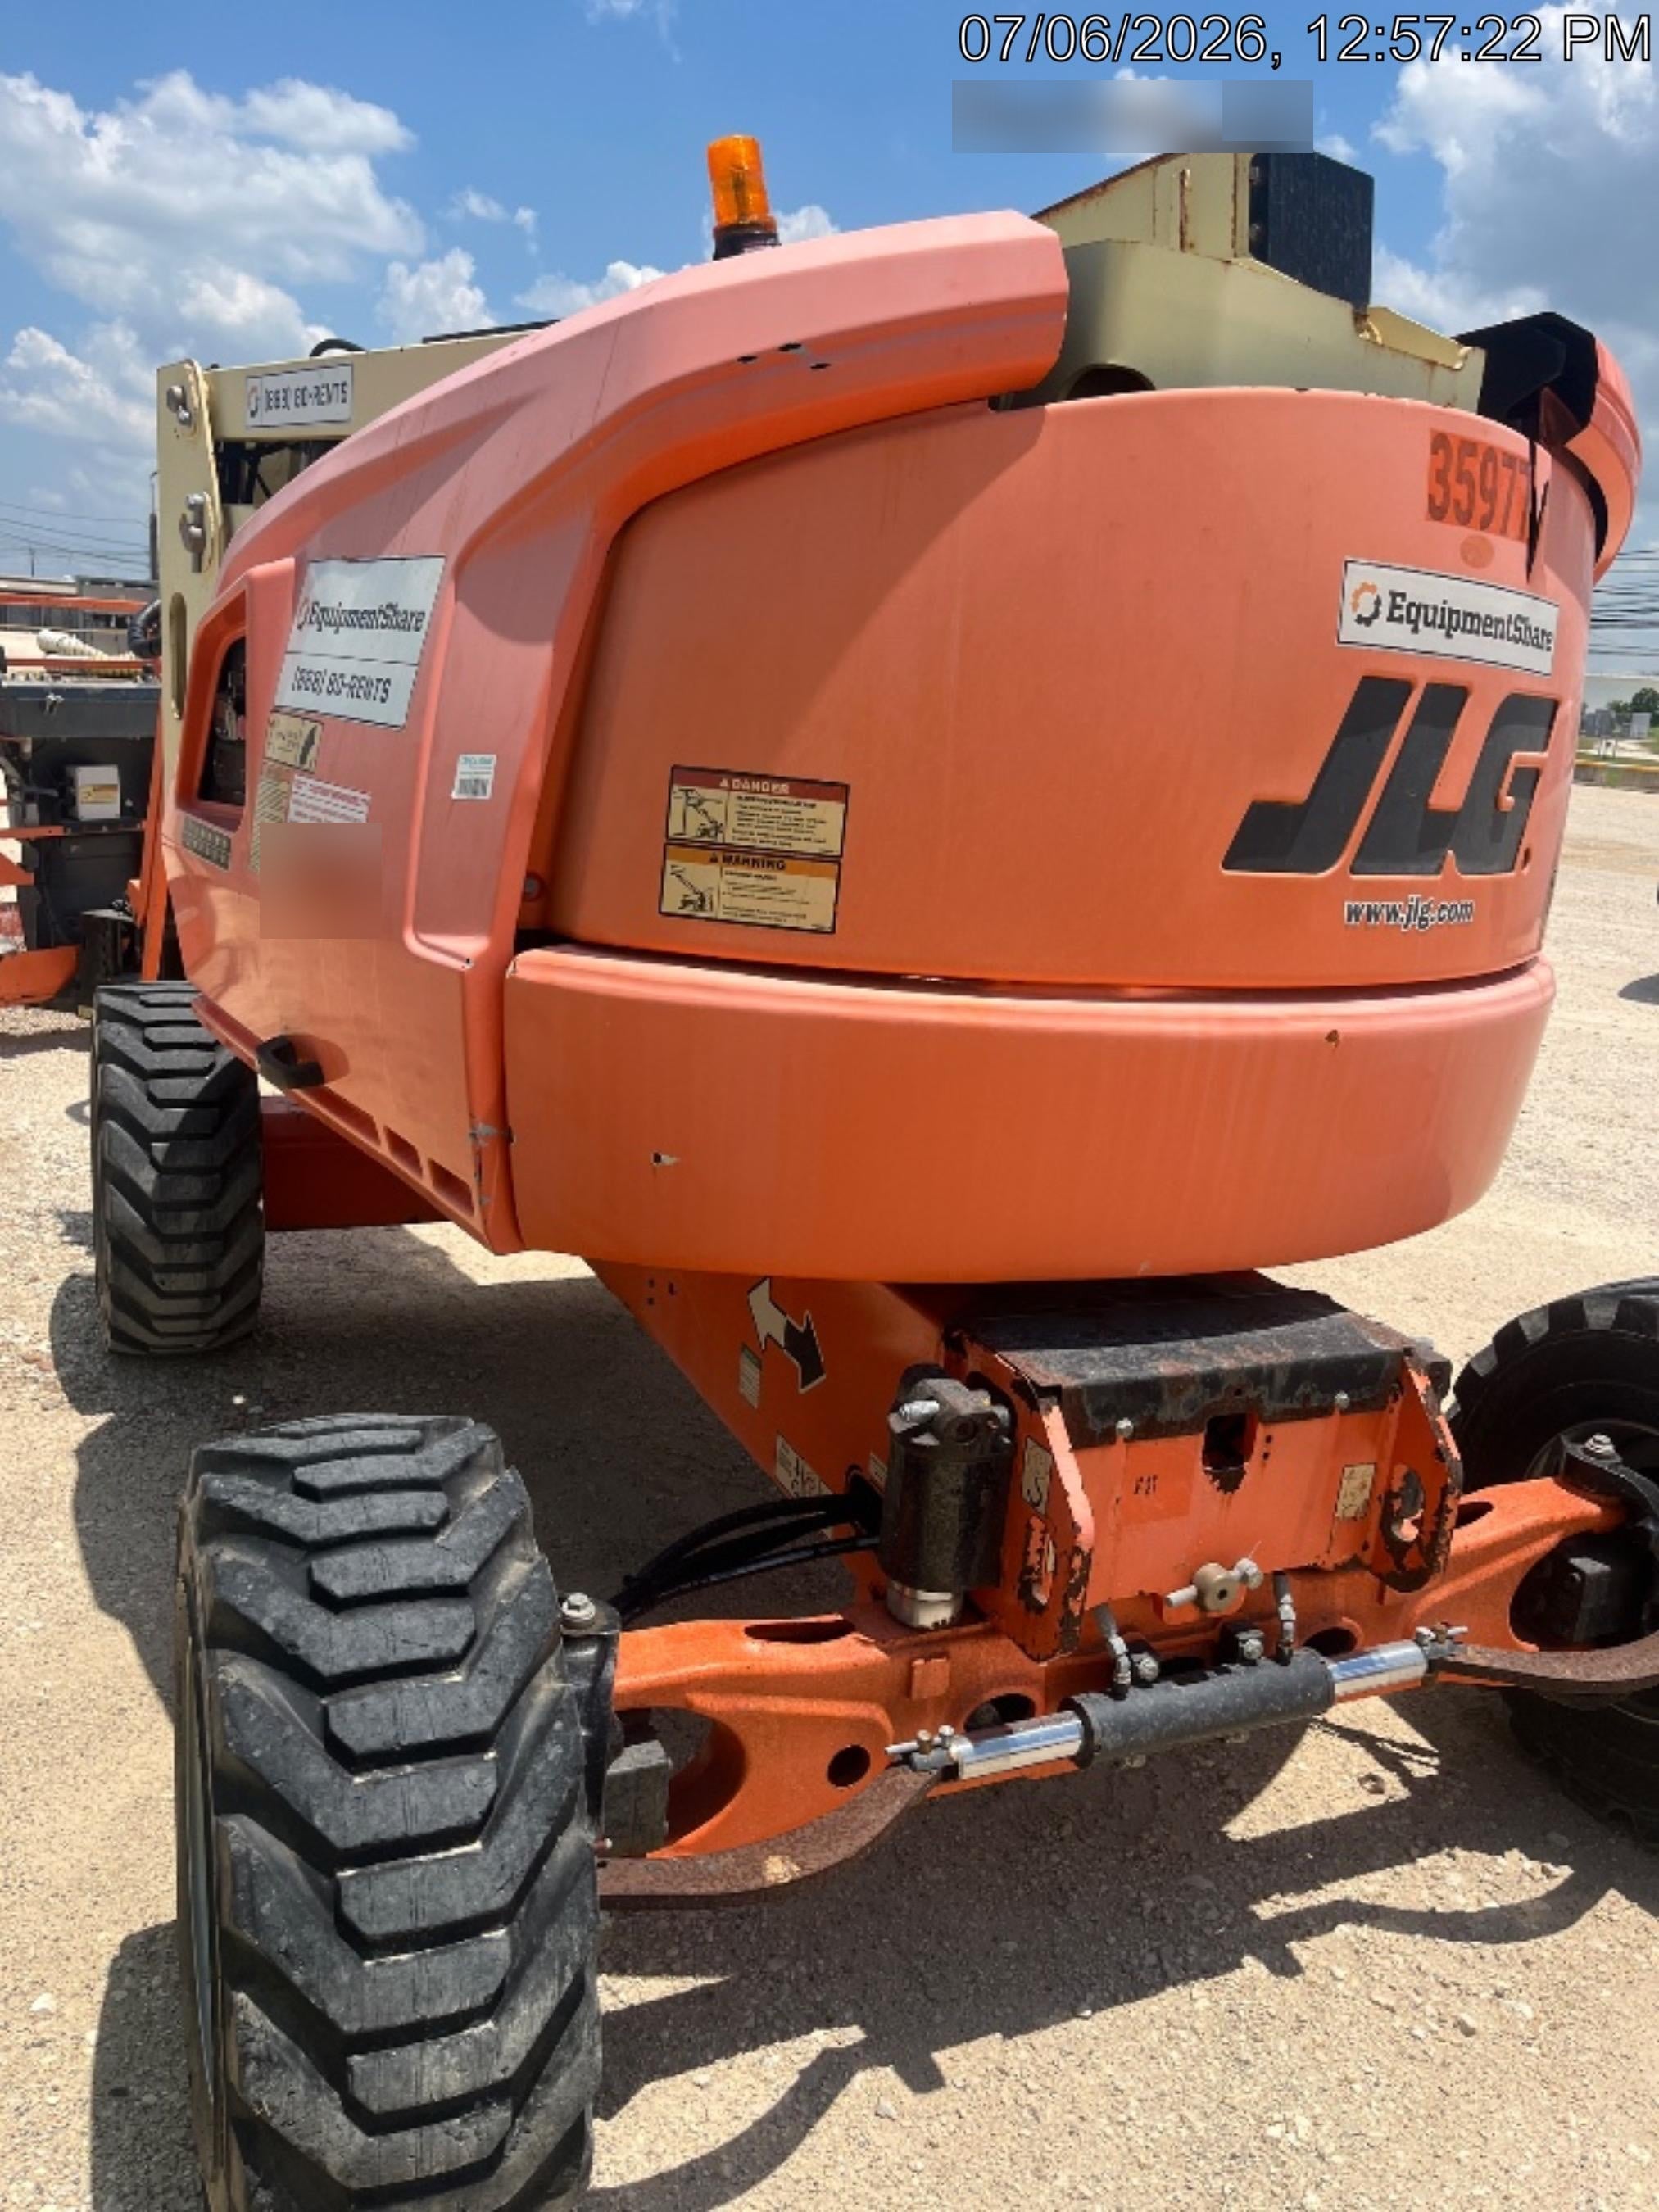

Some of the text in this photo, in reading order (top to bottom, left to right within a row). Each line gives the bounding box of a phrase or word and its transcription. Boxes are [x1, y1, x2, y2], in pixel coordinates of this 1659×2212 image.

[308, 601, 426, 634] EquipmentShare
[1386, 589, 1552, 652] EquipmentShare
[732, 778, 790, 795] DANGER
[1222, 674, 1559, 876] JLG
[722, 853, 786, 871] WARNING
[1344, 895, 1475, 931] www.jlg.com
